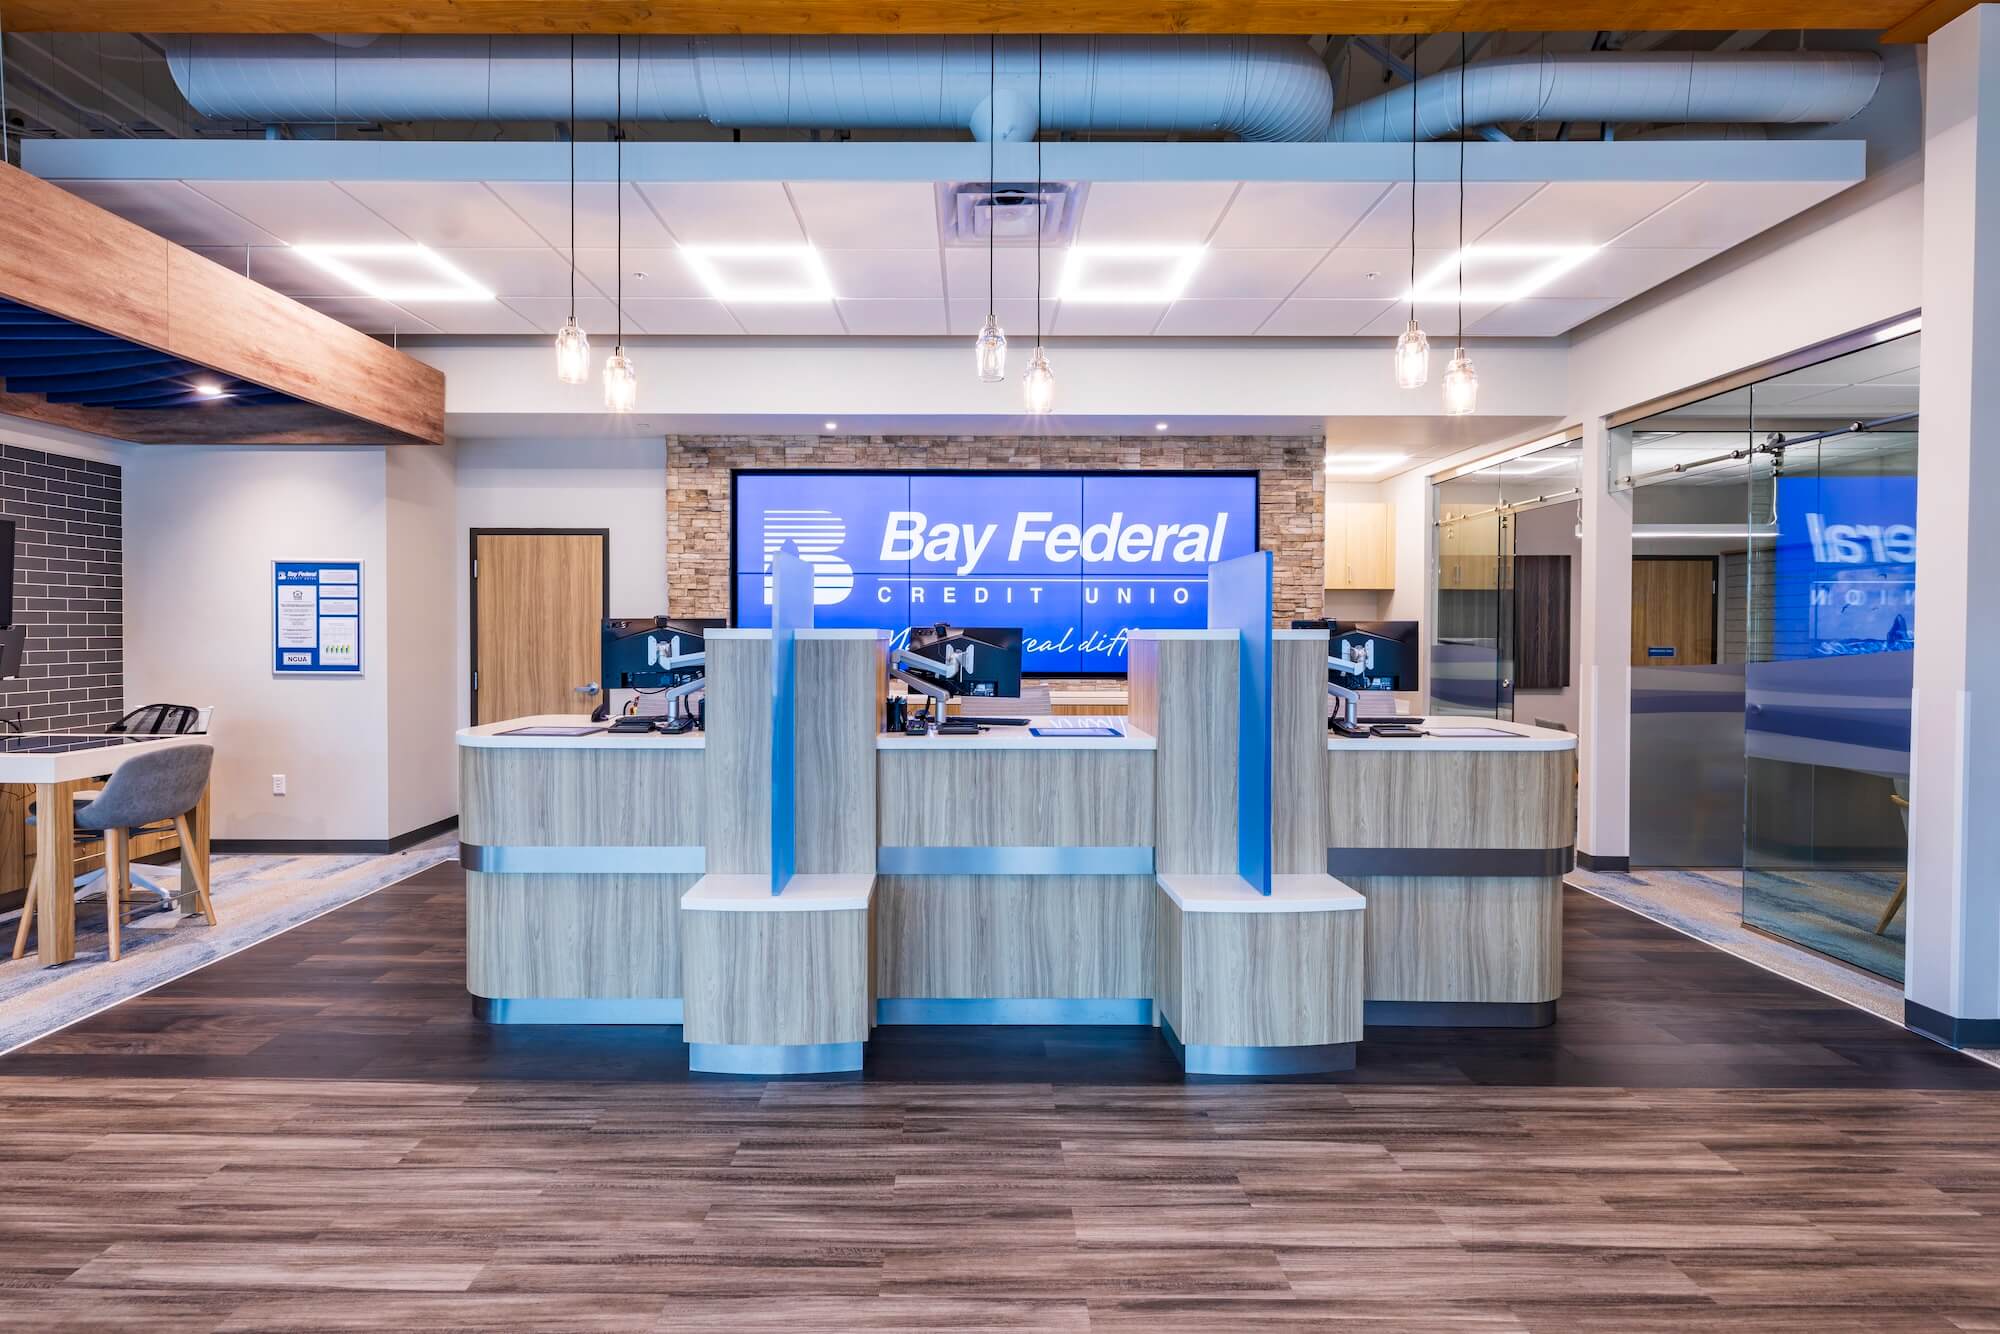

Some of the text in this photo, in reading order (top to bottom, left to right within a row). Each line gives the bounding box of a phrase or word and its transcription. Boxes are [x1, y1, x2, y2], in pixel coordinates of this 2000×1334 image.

[879, 511, 1228, 576] Bay Federal
[877, 586, 1189, 604] CREDIT UNIO
